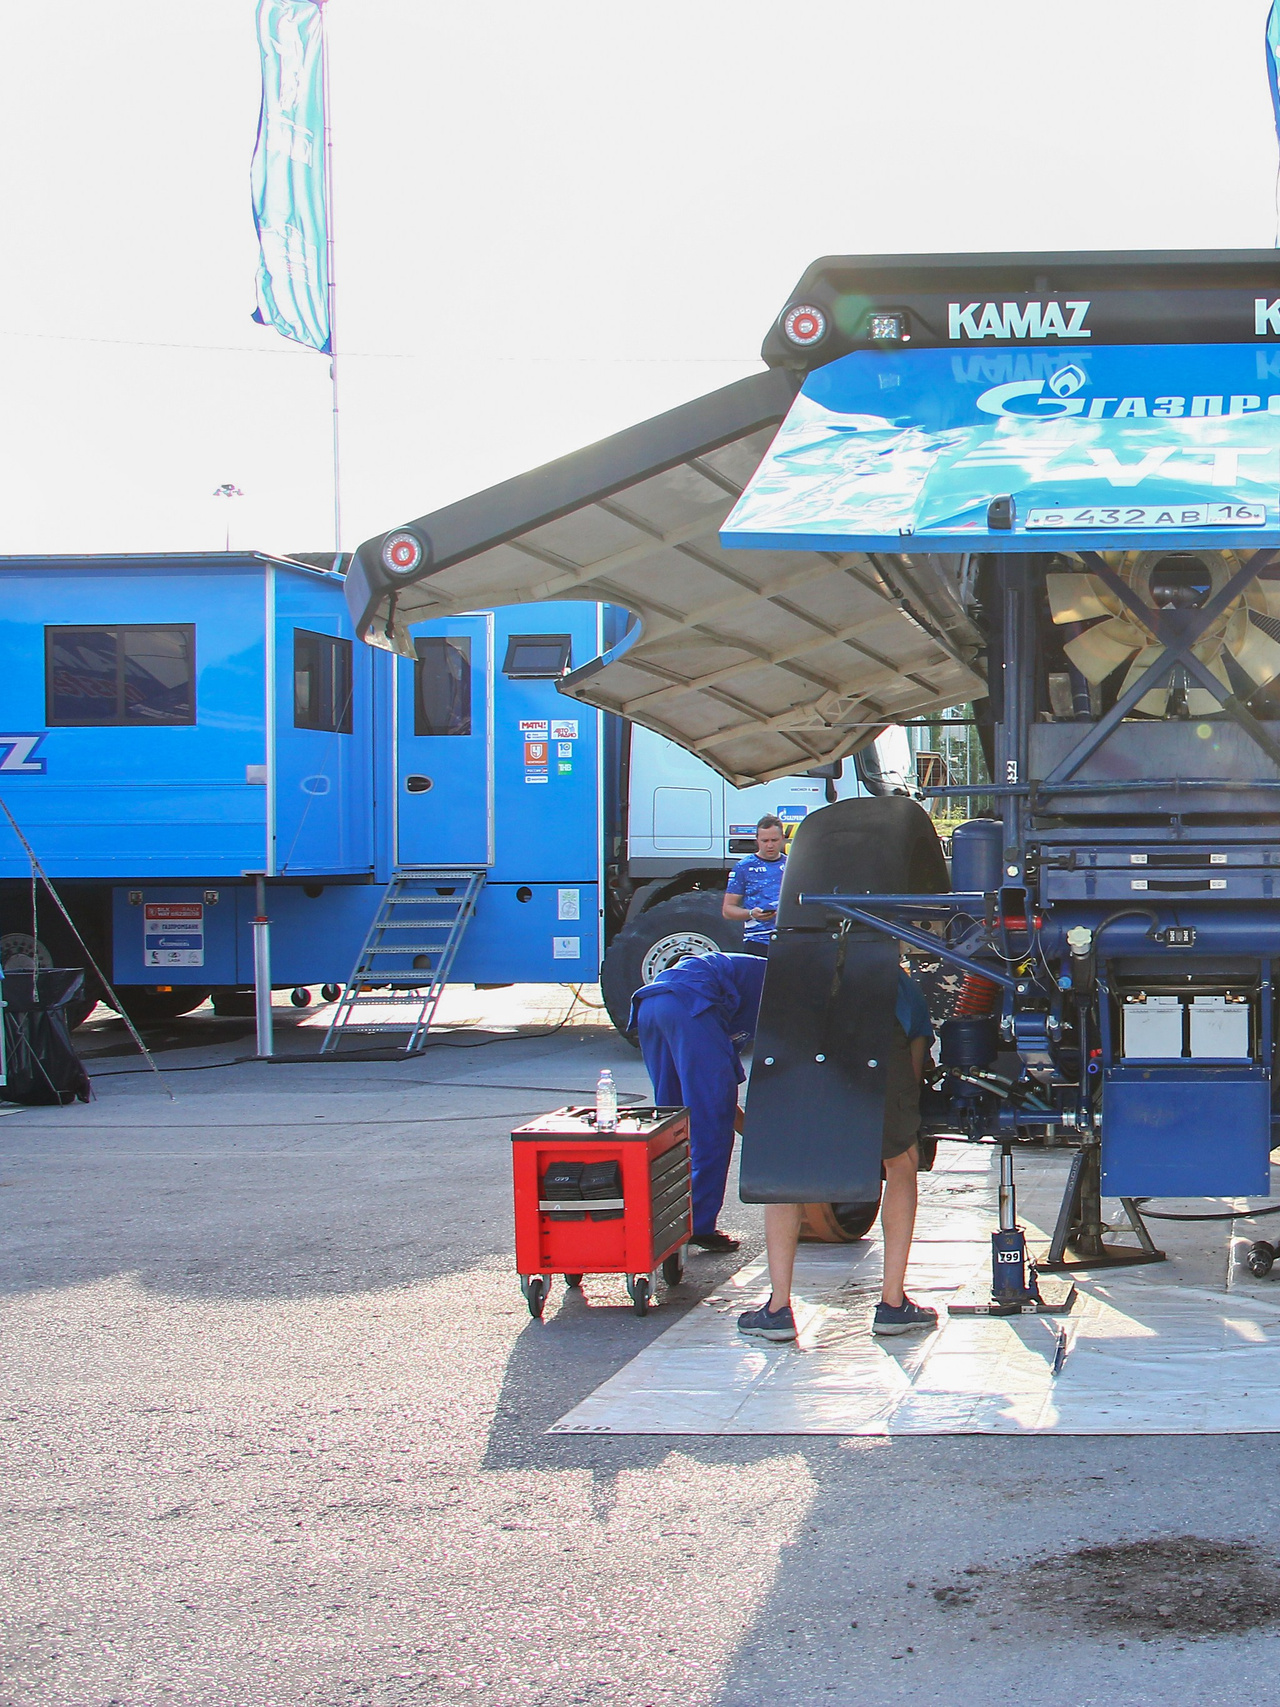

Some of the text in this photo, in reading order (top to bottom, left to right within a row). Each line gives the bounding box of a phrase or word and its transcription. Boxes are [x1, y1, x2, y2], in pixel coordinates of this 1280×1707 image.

[948, 301, 1092, 339] KAMAZ
[1073, 509, 1146, 525] 432
[1218, 505, 1253, 519] 16
[1000, 1252, 1019, 1261] 799
